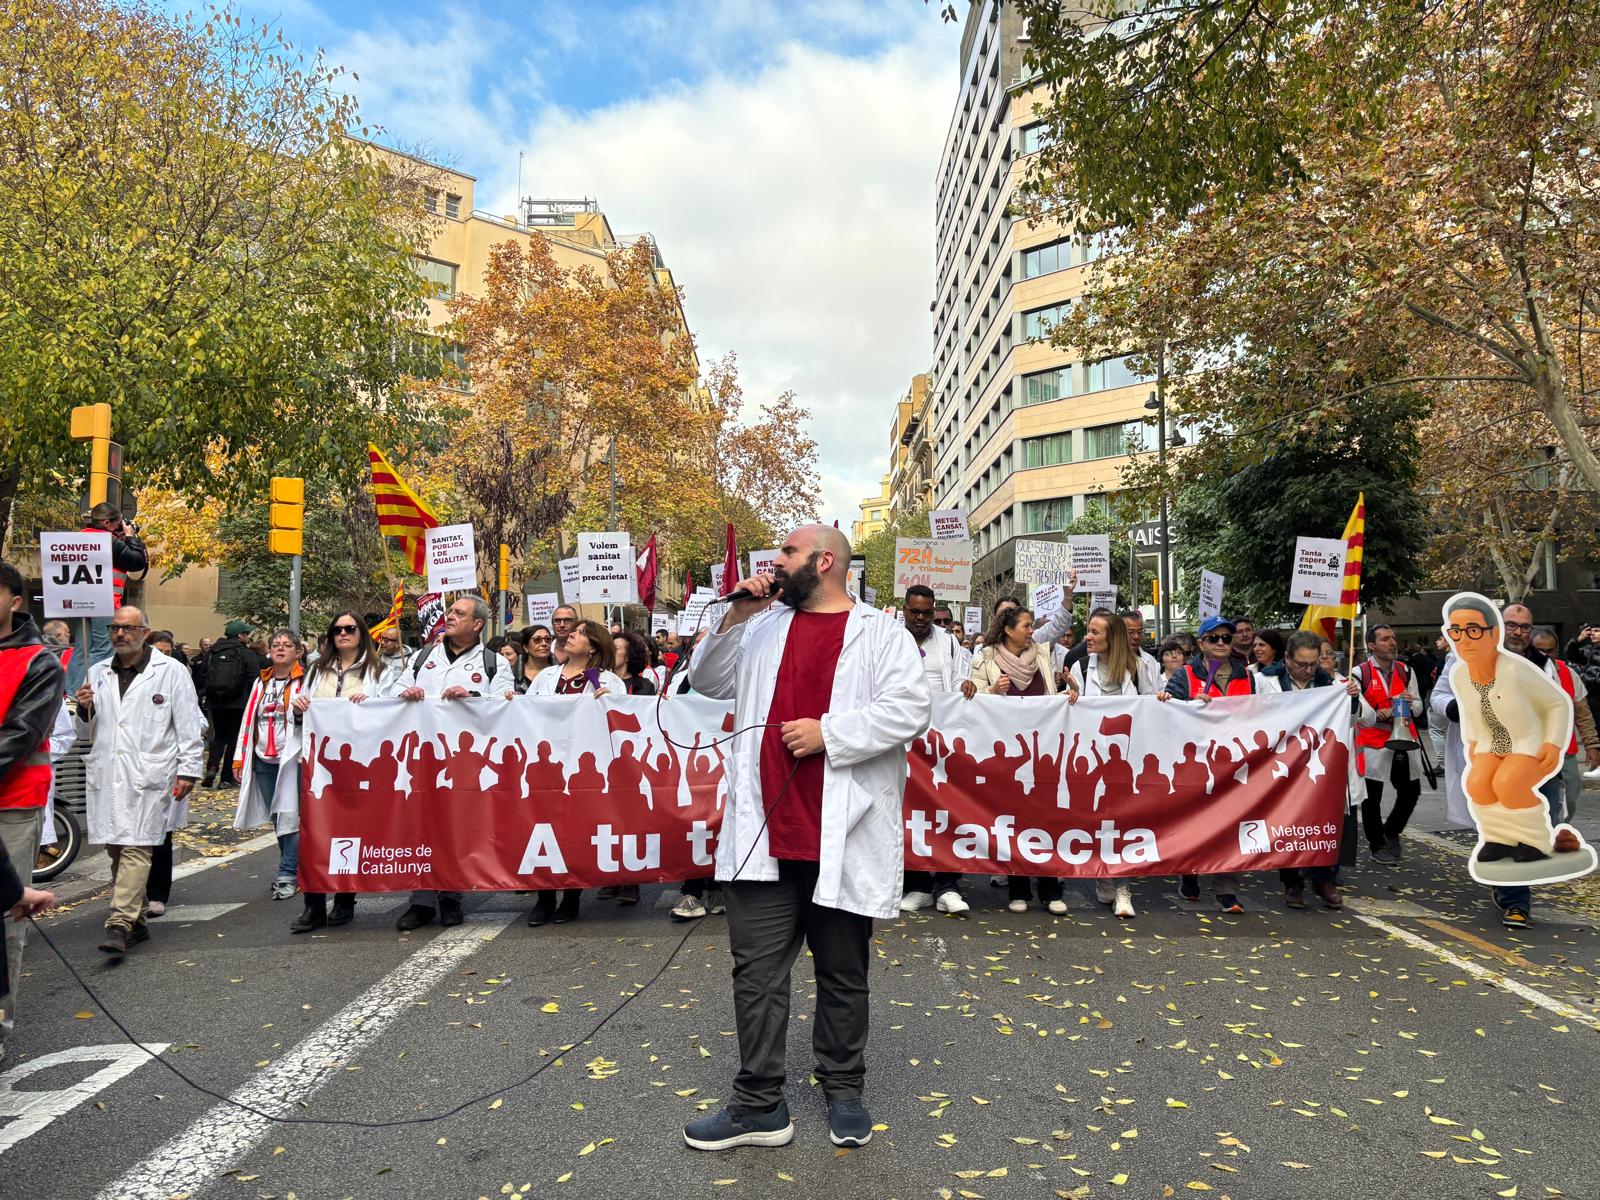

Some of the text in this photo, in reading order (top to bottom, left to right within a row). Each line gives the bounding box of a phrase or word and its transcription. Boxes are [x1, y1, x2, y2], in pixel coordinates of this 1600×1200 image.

[936, 523, 964, 531] CANSAT,
[432, 534, 464, 544] SANITAT,
[51, 543, 101, 552] CONVENI
[433, 541, 464, 551] PÚBLICA
[51, 552, 89, 562] MÈDIC
[433, 555, 469, 565] QUALITAT
[587, 552, 621, 560] sanitat
[898, 547, 933, 565] 72H
[53, 564, 103, 585] JA!
[582, 573, 628, 582] precarietat
[1298, 569, 1339, 578] desespera
[421, 610, 445, 641] VAGA
[1270, 822, 1337, 839] Metges de
[517, 822, 569, 875] A
[590, 823, 661, 873] tu
[1274, 839, 1338, 853] Catalunya
[362, 844, 432, 861] Metges de
[361, 861, 432, 876] Catalunya
